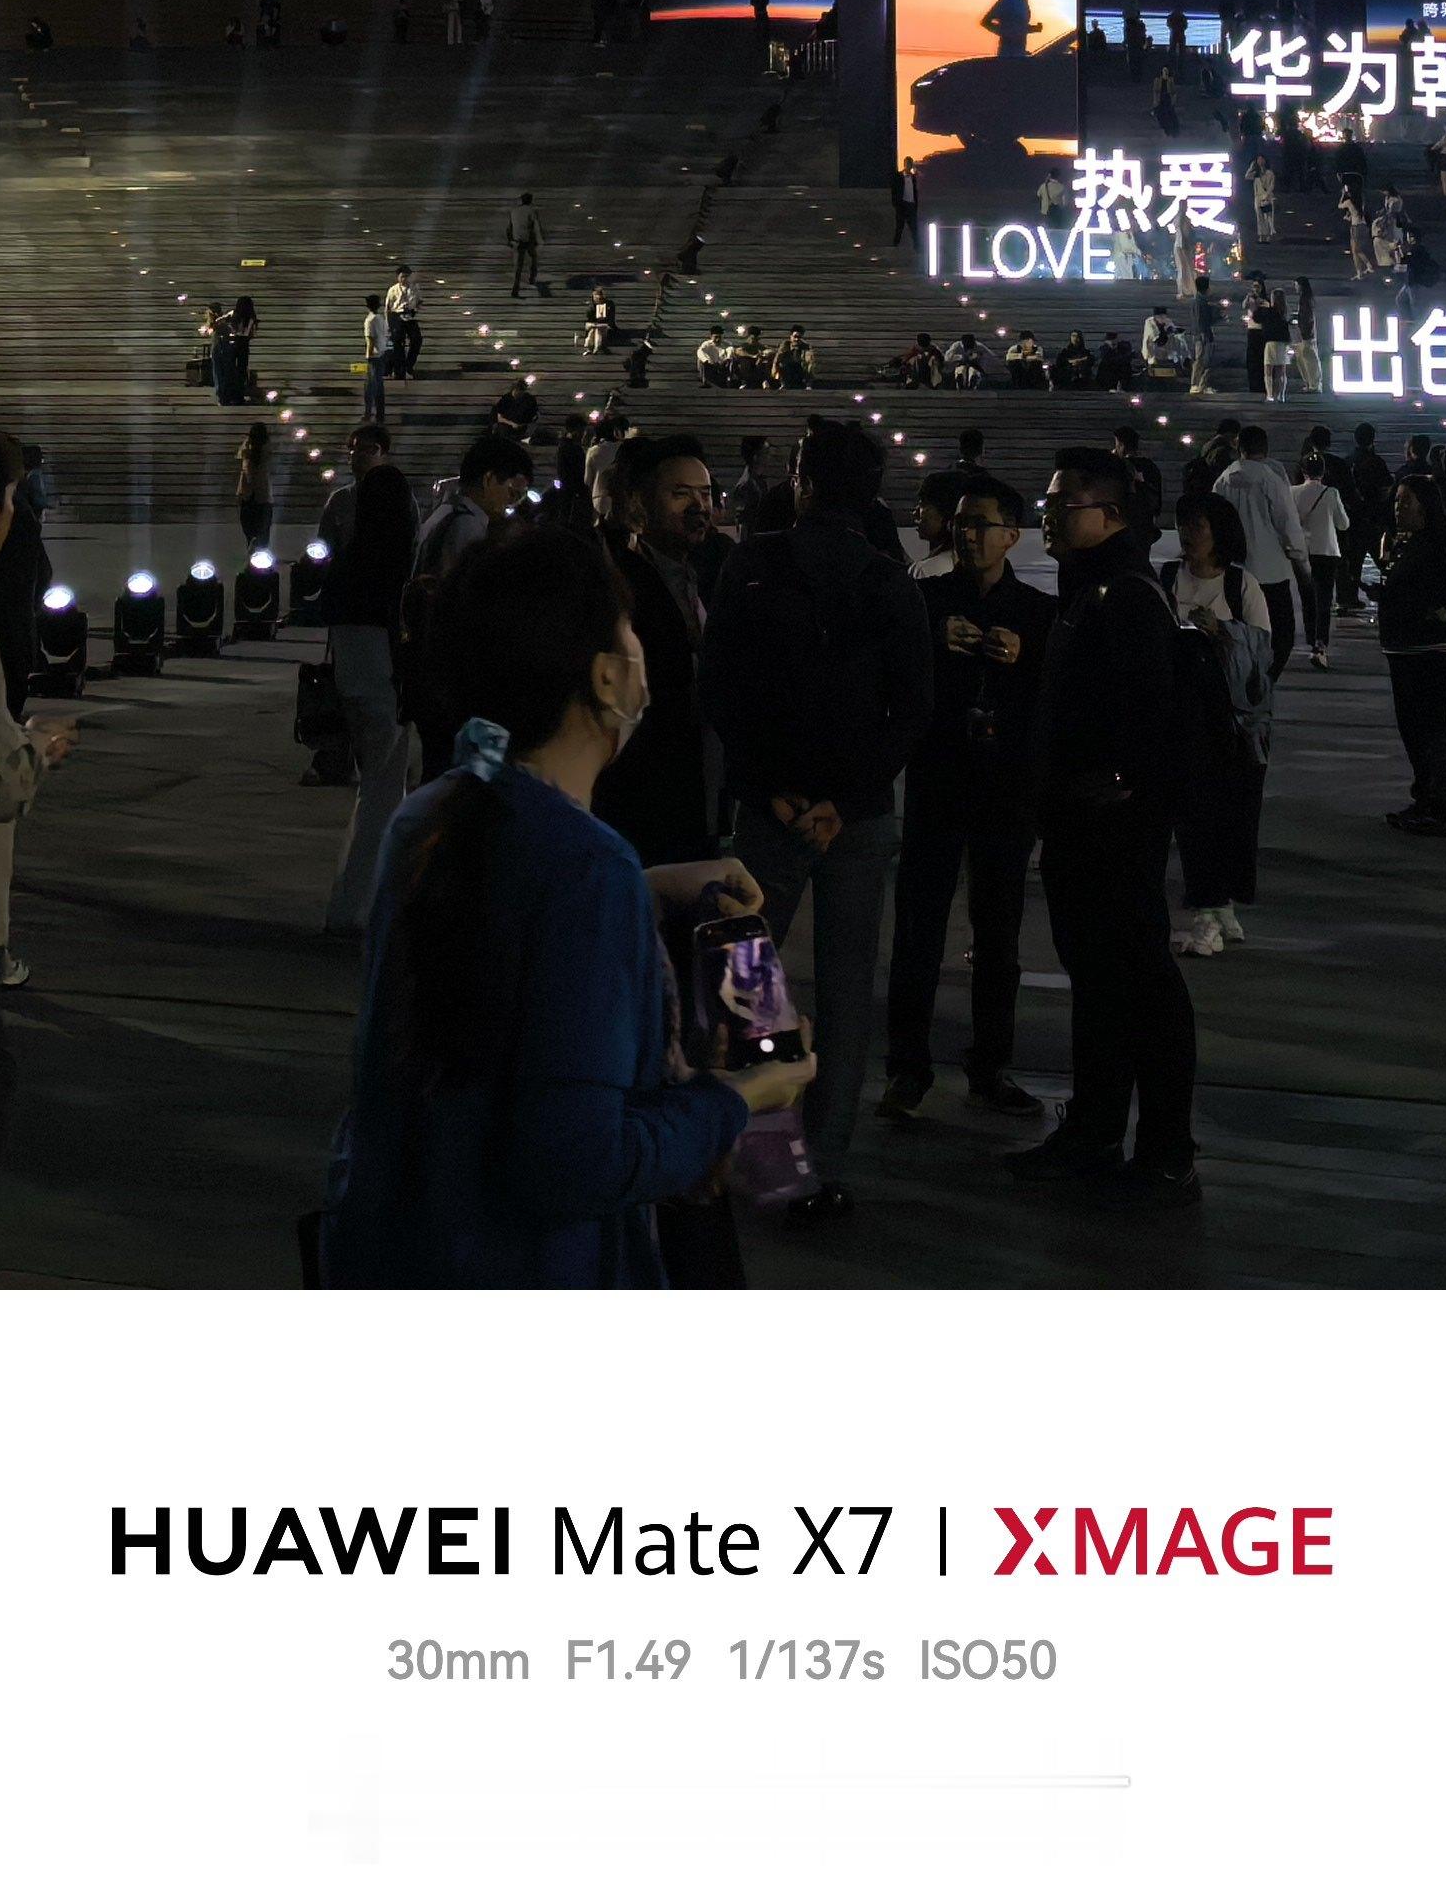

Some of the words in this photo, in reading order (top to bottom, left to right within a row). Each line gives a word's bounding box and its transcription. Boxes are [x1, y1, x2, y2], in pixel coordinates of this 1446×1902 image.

[1072, 147, 1235, 236] 热爱
[928, 222, 938, 277] I
[962, 223, 1116, 281] LOVE
